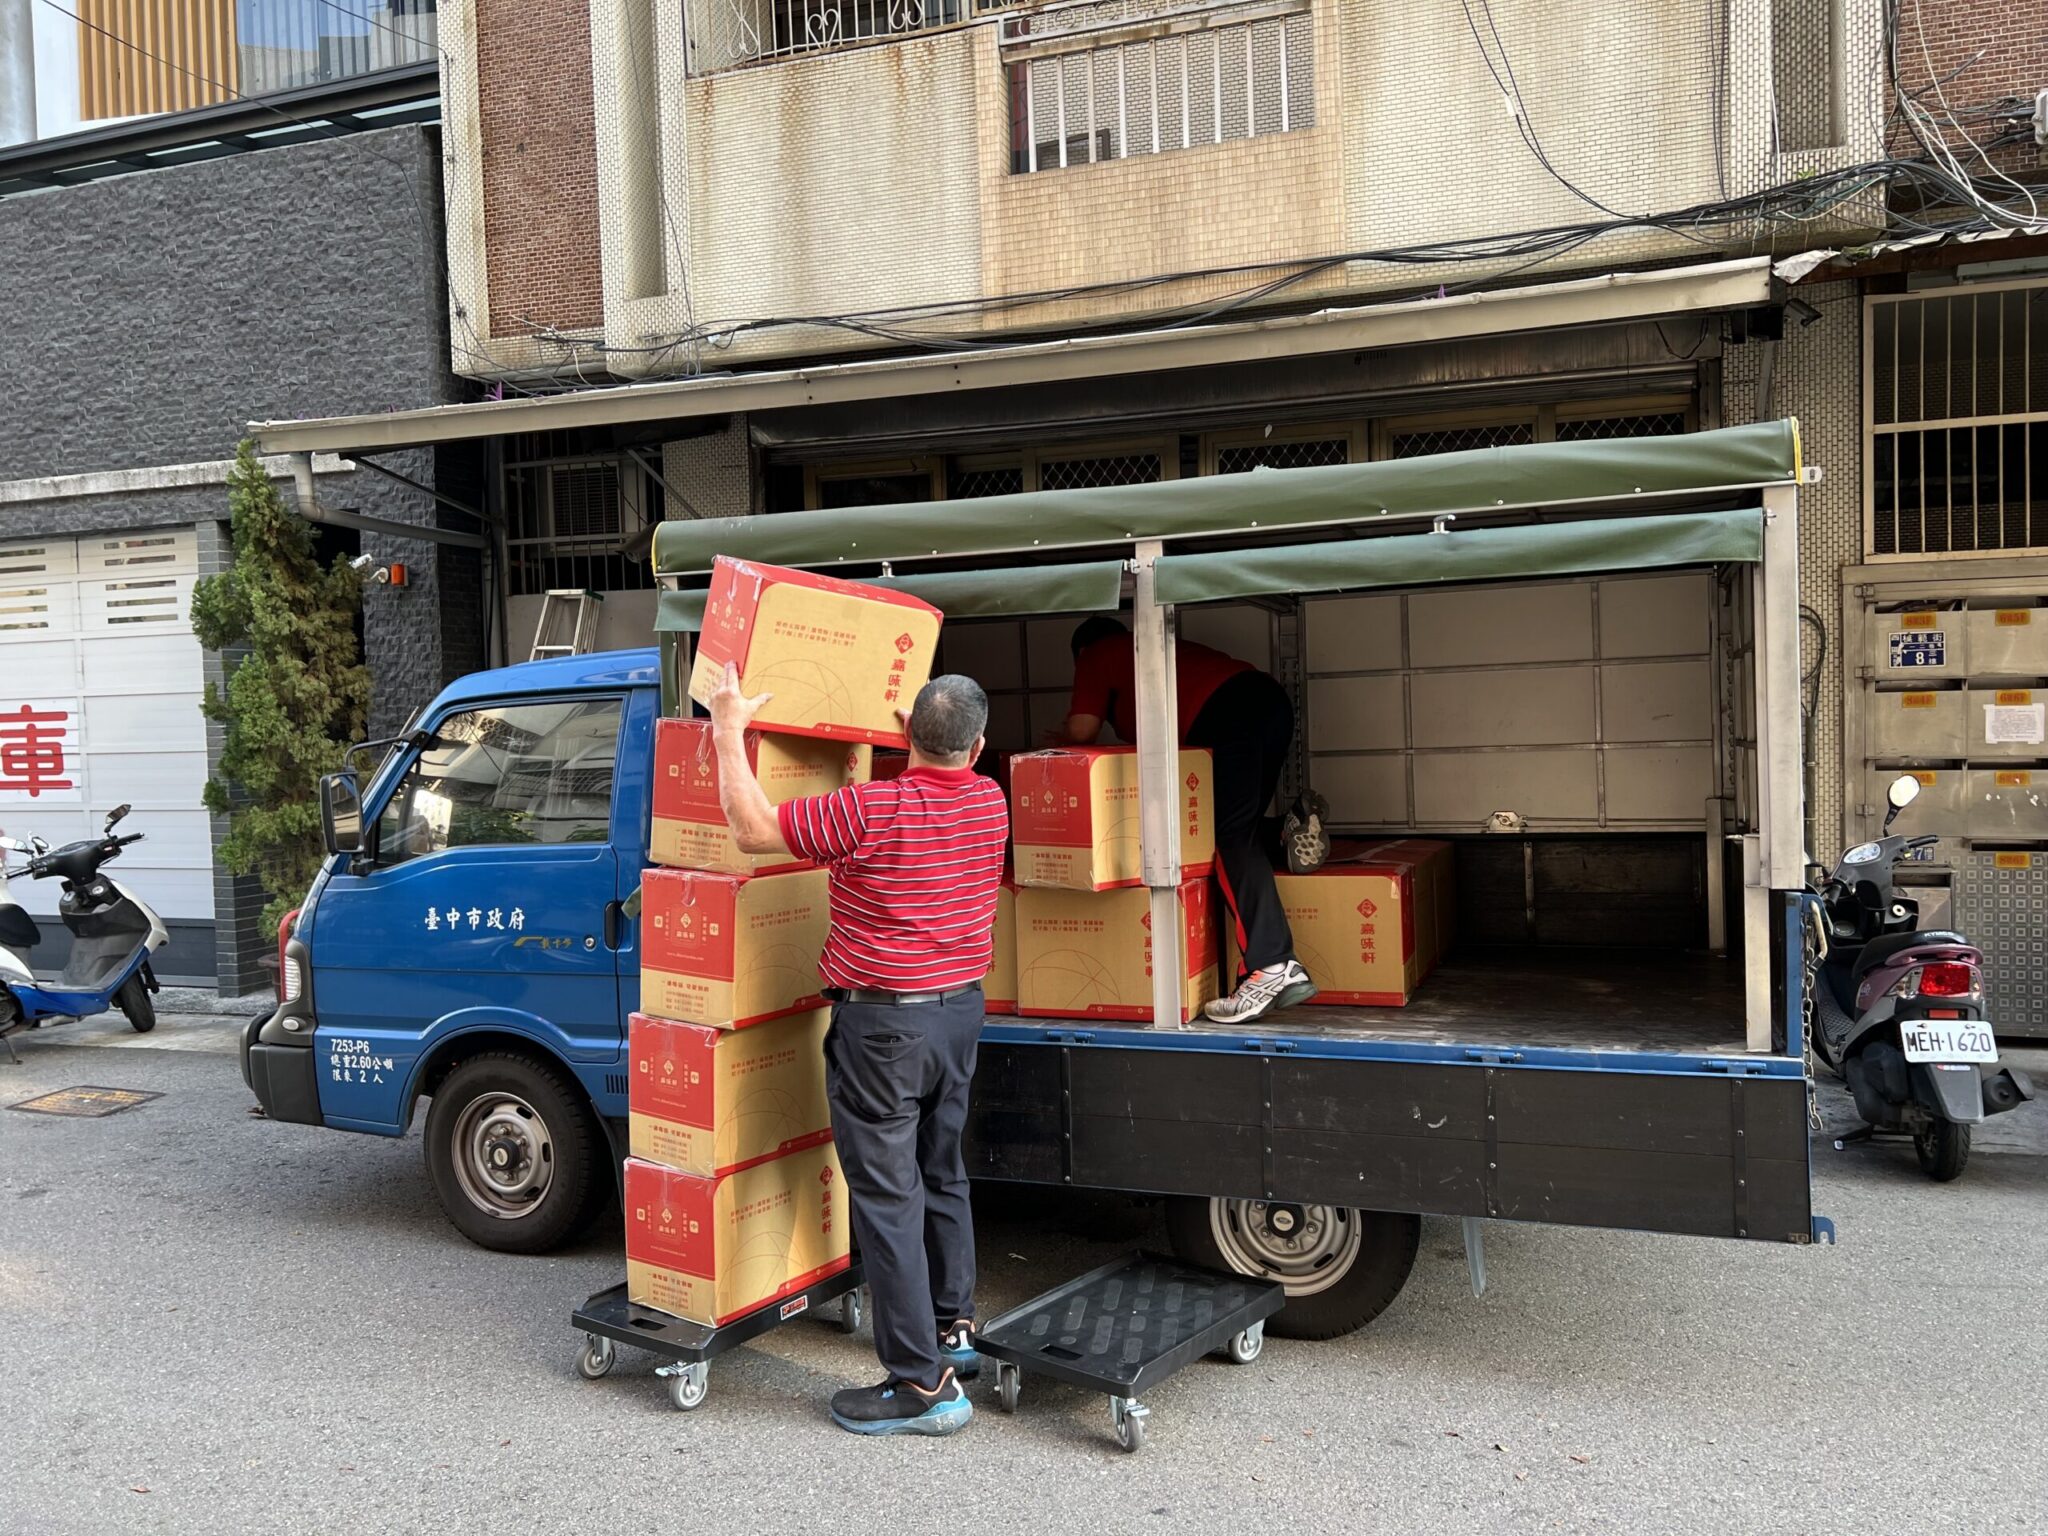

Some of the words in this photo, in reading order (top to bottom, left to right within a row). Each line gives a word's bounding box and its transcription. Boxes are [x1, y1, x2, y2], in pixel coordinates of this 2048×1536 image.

[1916, 651, 1925, 665] 8
[884, 658, 906, 702] 嘉味軒
[424, 906, 525, 931] 臺中市政府
[1360, 923, 1376, 964] 嘉味軒
[330, 1038, 370, 1054] 7253-P6
